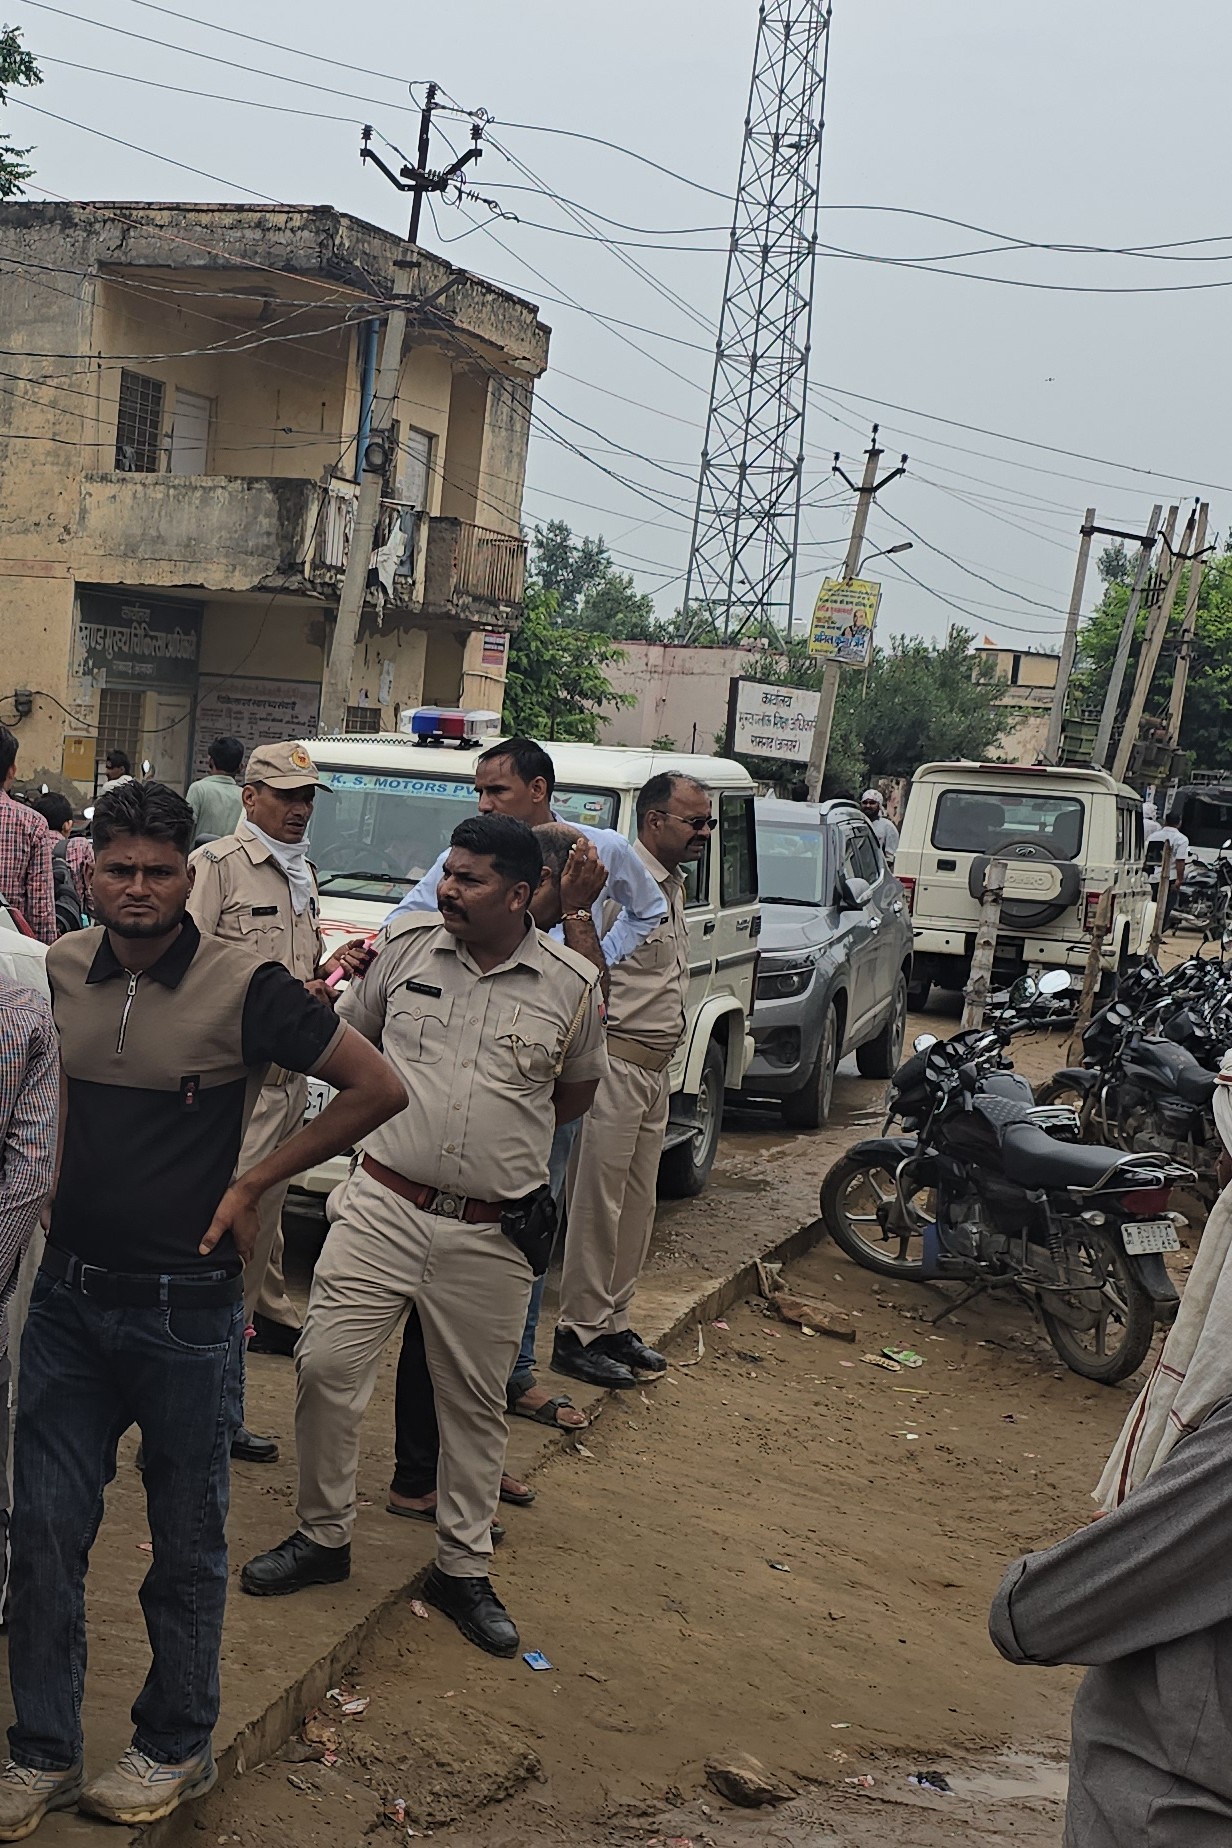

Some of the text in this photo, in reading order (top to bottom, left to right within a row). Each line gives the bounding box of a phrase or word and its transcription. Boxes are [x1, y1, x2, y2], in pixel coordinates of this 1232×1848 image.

[762, 689, 793, 708] कार्यालय
[331, 774, 346, 785] K.
[353, 776, 367, 787] S.
[374, 777, 448, 793] MOTORS
[452, 784, 475, 796] PV
